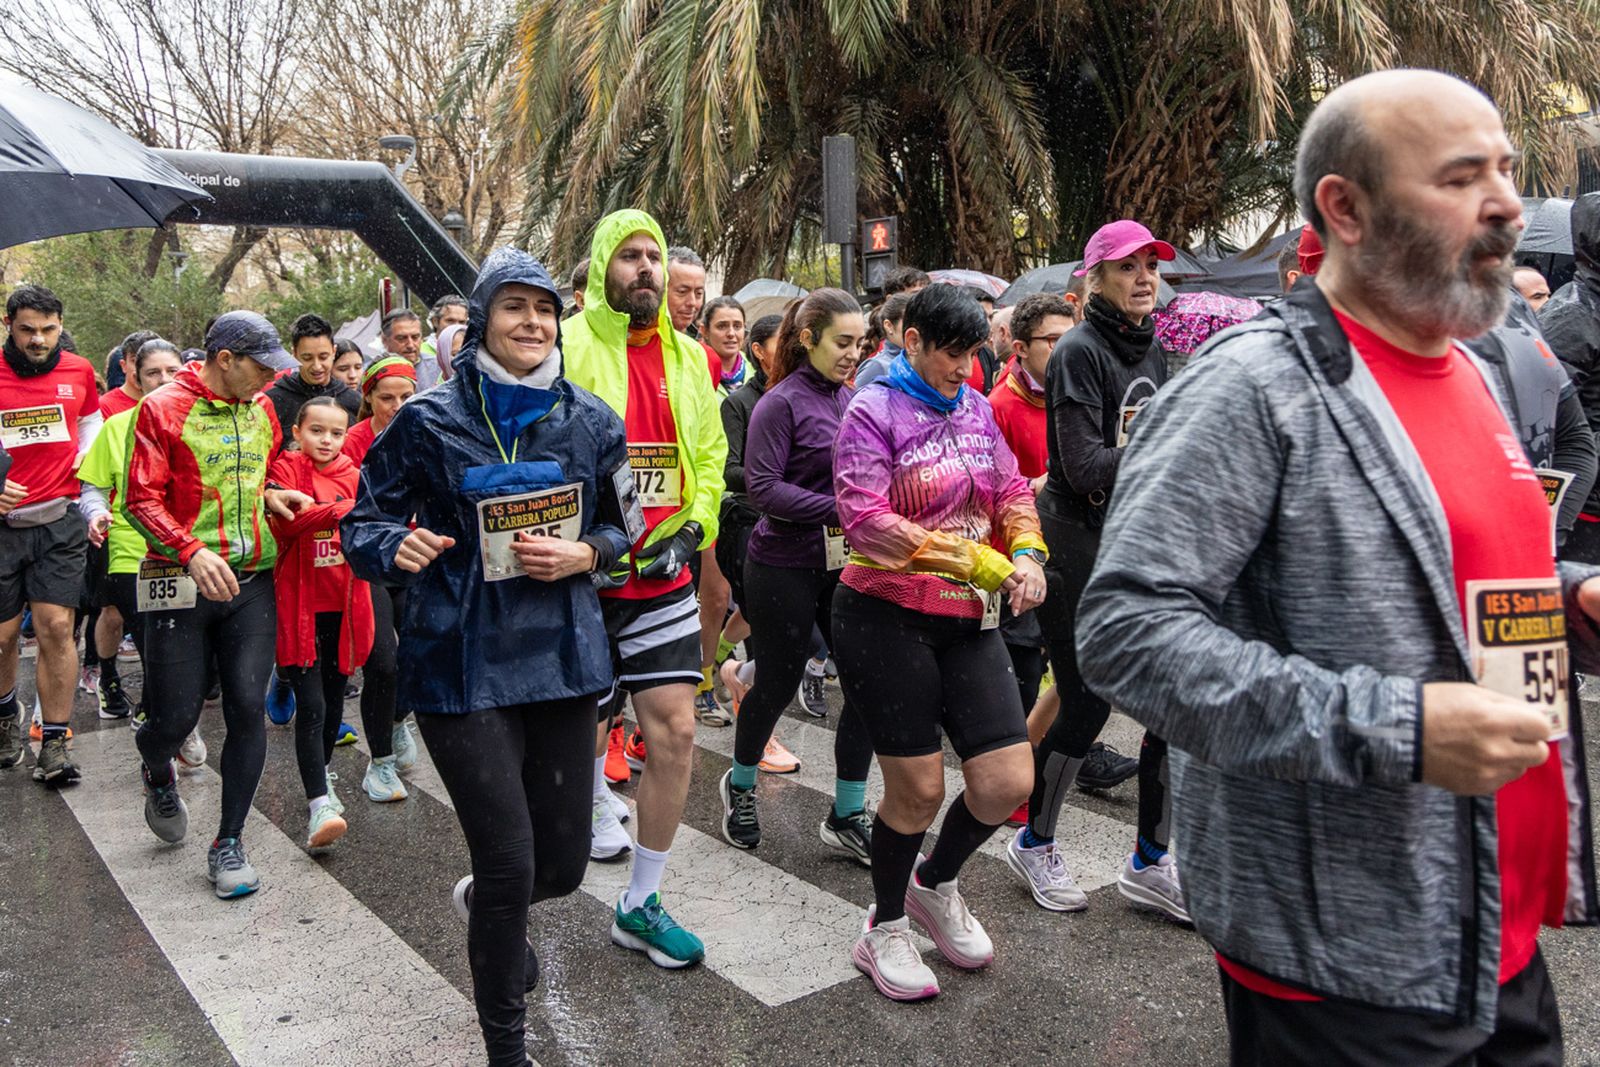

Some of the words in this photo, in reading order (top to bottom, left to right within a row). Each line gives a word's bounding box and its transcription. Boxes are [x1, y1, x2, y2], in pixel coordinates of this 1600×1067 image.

[223, 175, 241, 187] de
[18, 425, 50, 440] 353
[627, 448, 640, 456] San
[900, 440, 943, 466] club
[488, 518, 496, 531] V
[498, 512, 541, 529] CARRERA
[543, 502, 578, 522] POPULAR
[507, 502, 526, 515] San
[528, 498, 550, 511] Juan
[149, 579, 177, 600] 835
[1485, 593, 1511, 615] IES
[1512, 592, 1537, 614] San
[1482, 619, 1496, 642] V
[1498, 616, 1552, 642] CARRERA
